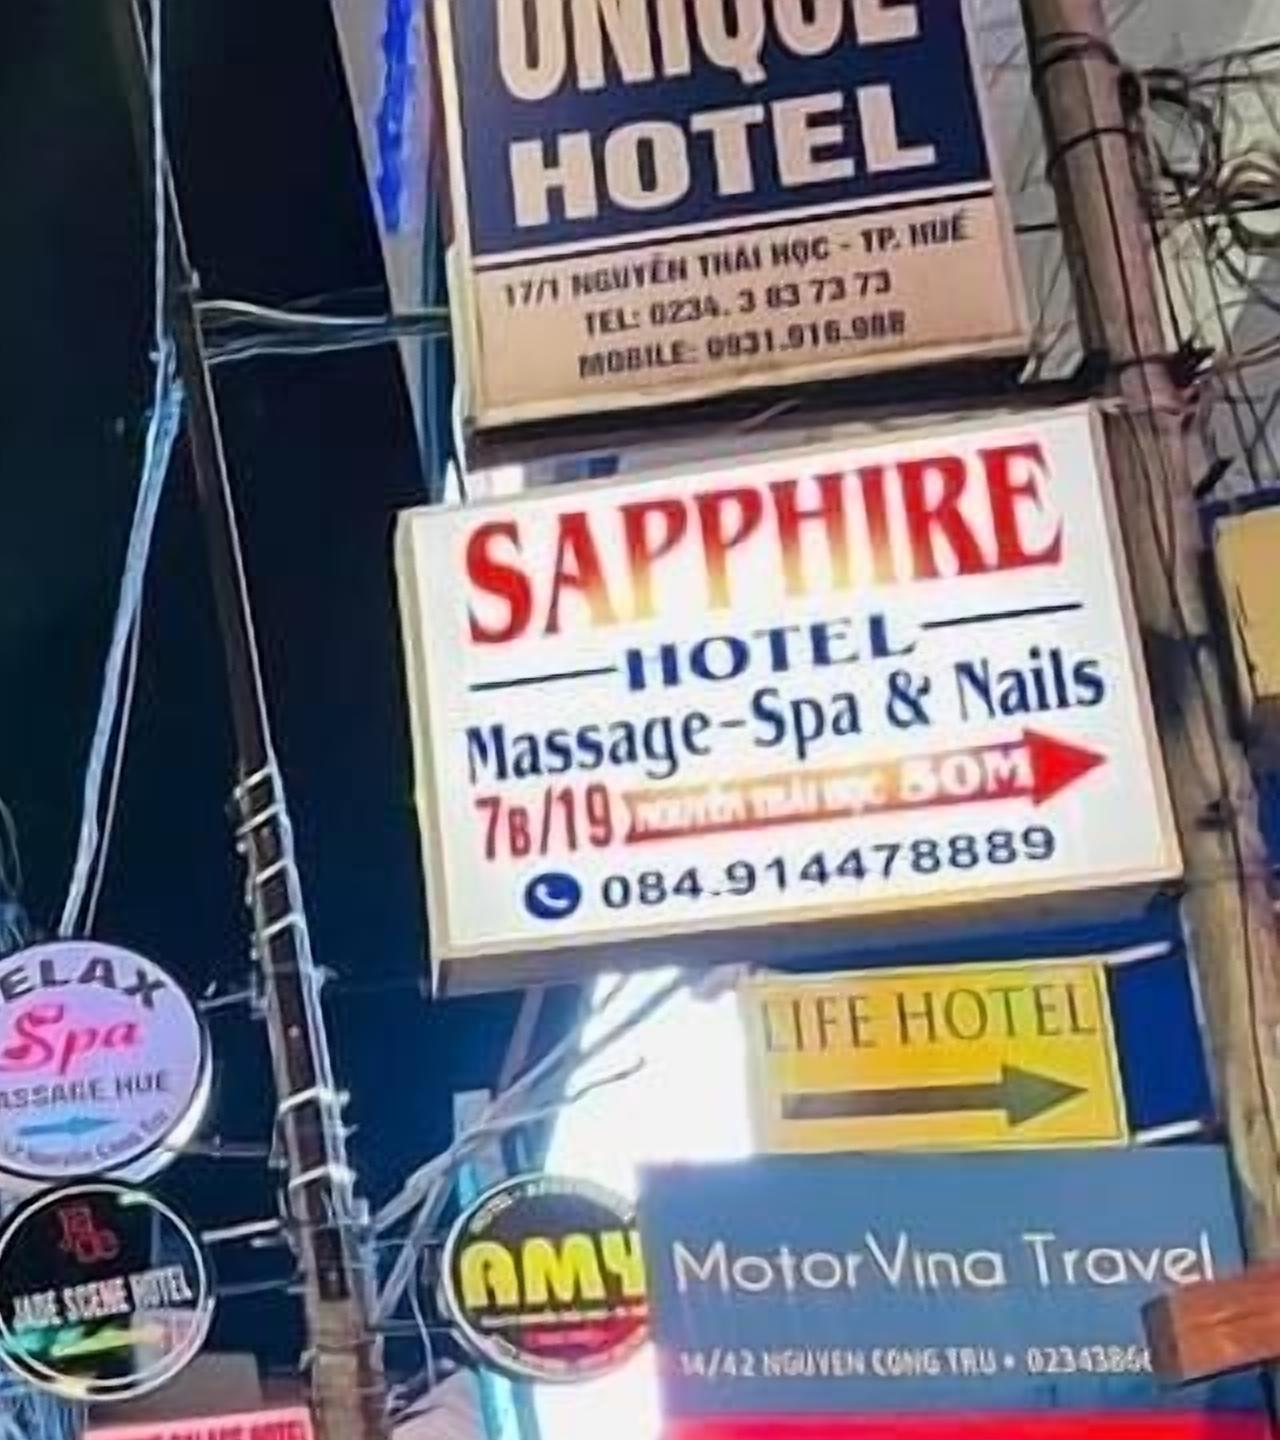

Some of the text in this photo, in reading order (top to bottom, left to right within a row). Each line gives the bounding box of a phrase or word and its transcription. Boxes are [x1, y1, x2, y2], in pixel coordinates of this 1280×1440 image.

[508, 84, 936, 227] HOTEL
[504, 276, 560, 307] 17/1
[860, 226, 901, 253] TP.
[584, 309, 641, 336] TEL:
[649, 294, 732, 326] 0234.
[739, 289, 757, 314] 3
[807, 276, 848, 303] 73
[853, 269, 893, 297] 73
[577, 337, 699, 380] MOBILE:
[464, 440, 1065, 647] SAPPHIRE
[626, 612, 919, 692] HOTEL
[465, 645, 1107, 787] Massage-Spa & Nails
[902, 745, 1037, 800] 50M
[602, 826, 1056, 909] 084.914478889
[761, 982, 1099, 1054] LIFE HOTEL
[459, 1229, 647, 1310] AMY
[1023, 1230, 1217, 1287] Travel
